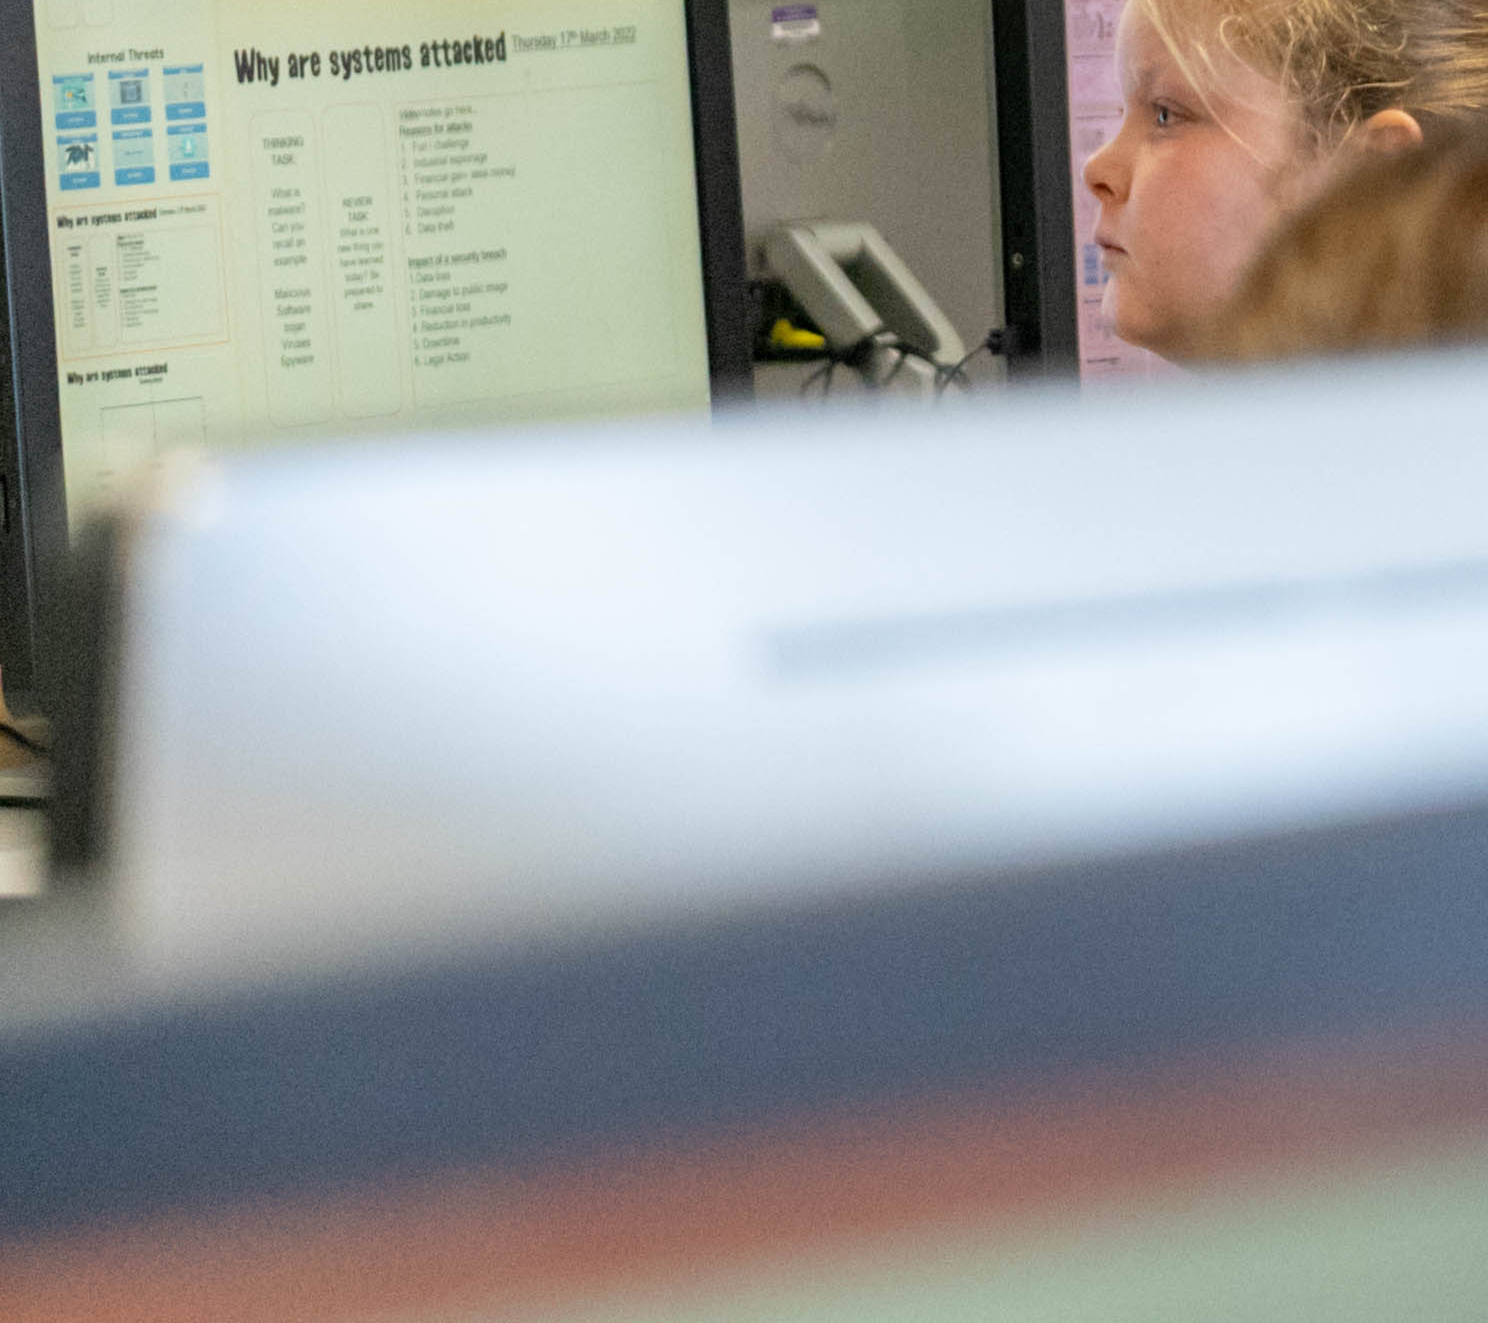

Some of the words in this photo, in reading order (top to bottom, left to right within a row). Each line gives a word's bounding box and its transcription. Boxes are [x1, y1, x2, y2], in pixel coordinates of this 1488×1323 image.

[511, 31, 557, 53] Thursday
[580, 27, 610, 45] March
[87, 51, 126, 65] Internal
[127, 47, 165, 61] Threats
[233, 47, 280, 87] Why
[287, 52, 321, 78] are
[329, 44, 413, 81] systems
[419, 31, 507, 67] attacked
[56, 215, 74, 229] Why
[67, 370, 84, 386] Why
